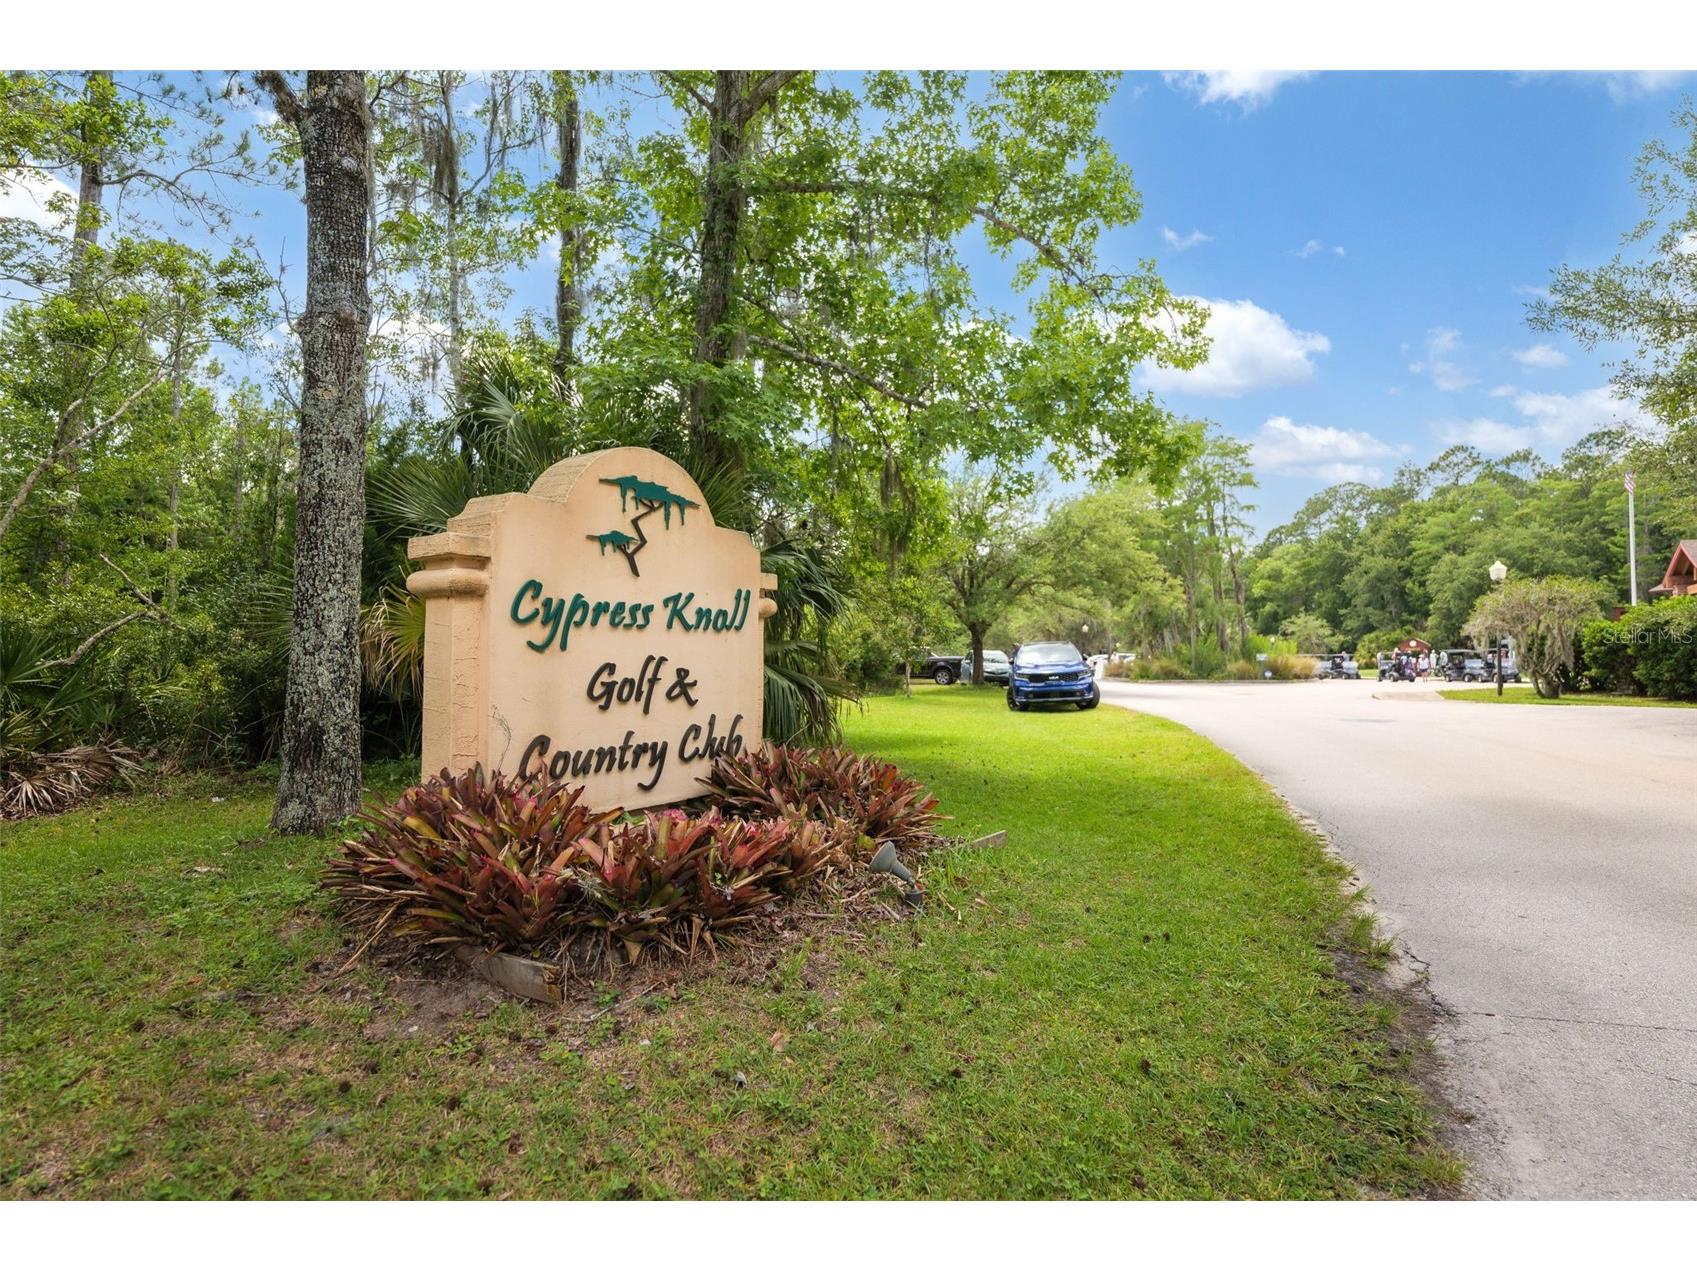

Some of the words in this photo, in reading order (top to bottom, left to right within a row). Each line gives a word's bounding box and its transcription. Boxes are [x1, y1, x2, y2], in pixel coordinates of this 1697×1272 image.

[510, 579, 653, 653] Cypress
[663, 588, 751, 632] Knoll
[586, 655, 669, 714] Golf
[665, 667, 698, 707] &
[519, 731, 668, 791] Country
[678, 713, 744, 764] Club
